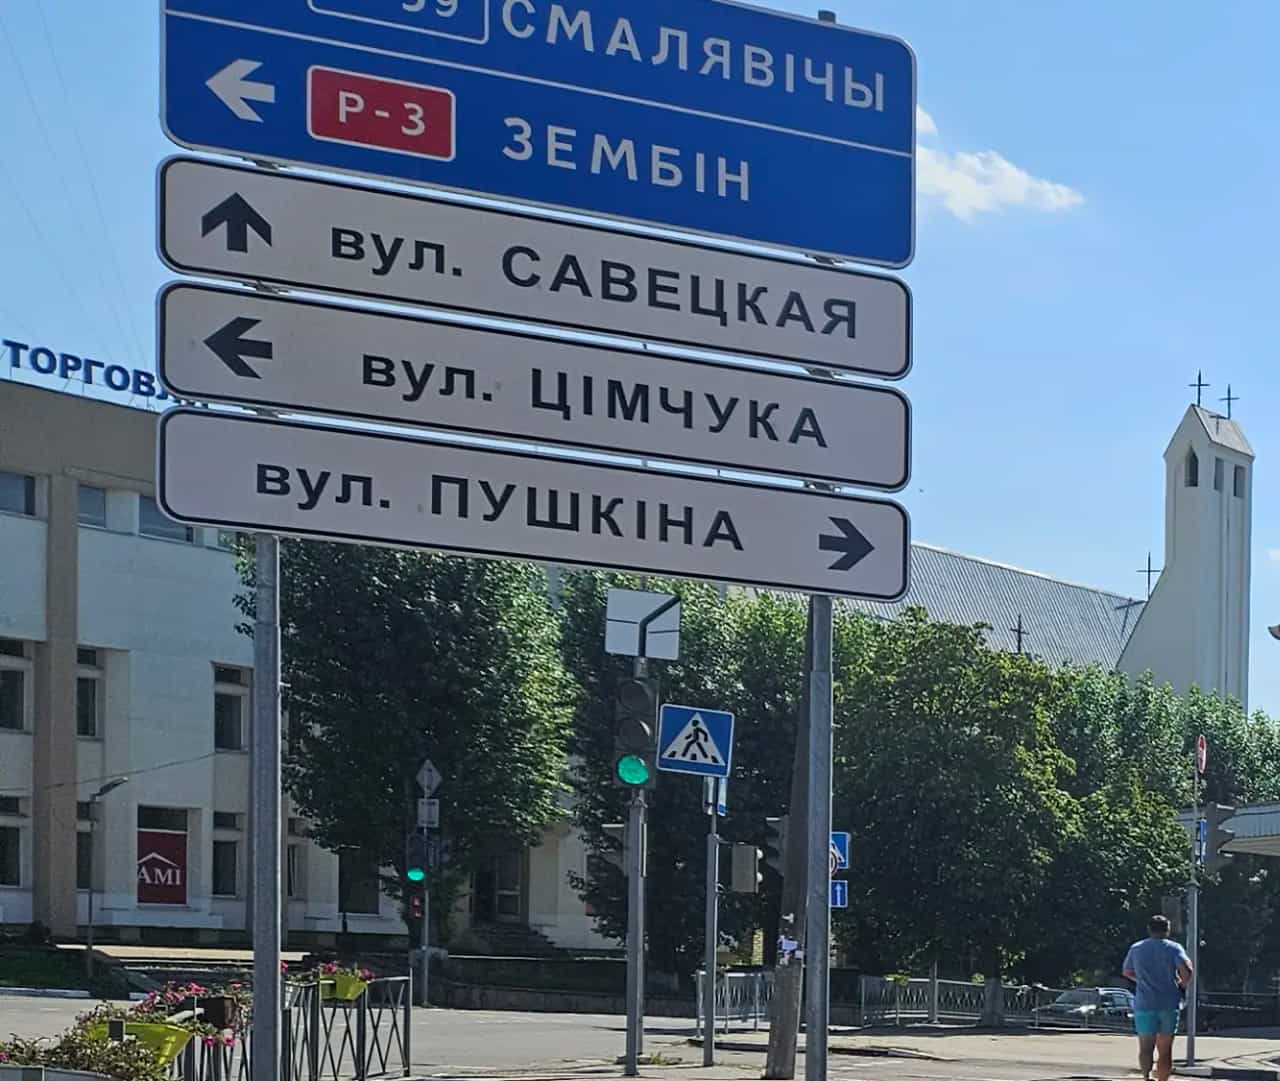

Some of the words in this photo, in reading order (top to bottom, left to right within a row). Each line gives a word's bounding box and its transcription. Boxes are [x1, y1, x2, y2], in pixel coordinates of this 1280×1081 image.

[502, 0, 886, 113] СМАЛЯВІЧЫ
[337, 91, 427, 137] Р-3
[502, 117, 751, 202] ЗЕМБІН
[331, 226, 464, 279] вул.
[502, 246, 859, 340] САВЕЦКАЯ
[363, 354, 493, 403] вул.
[531, 369, 828, 449] ЦІМЧУКА
[257, 462, 389, 511] вул.
[431, 474, 744, 552] ПУШКІНА
